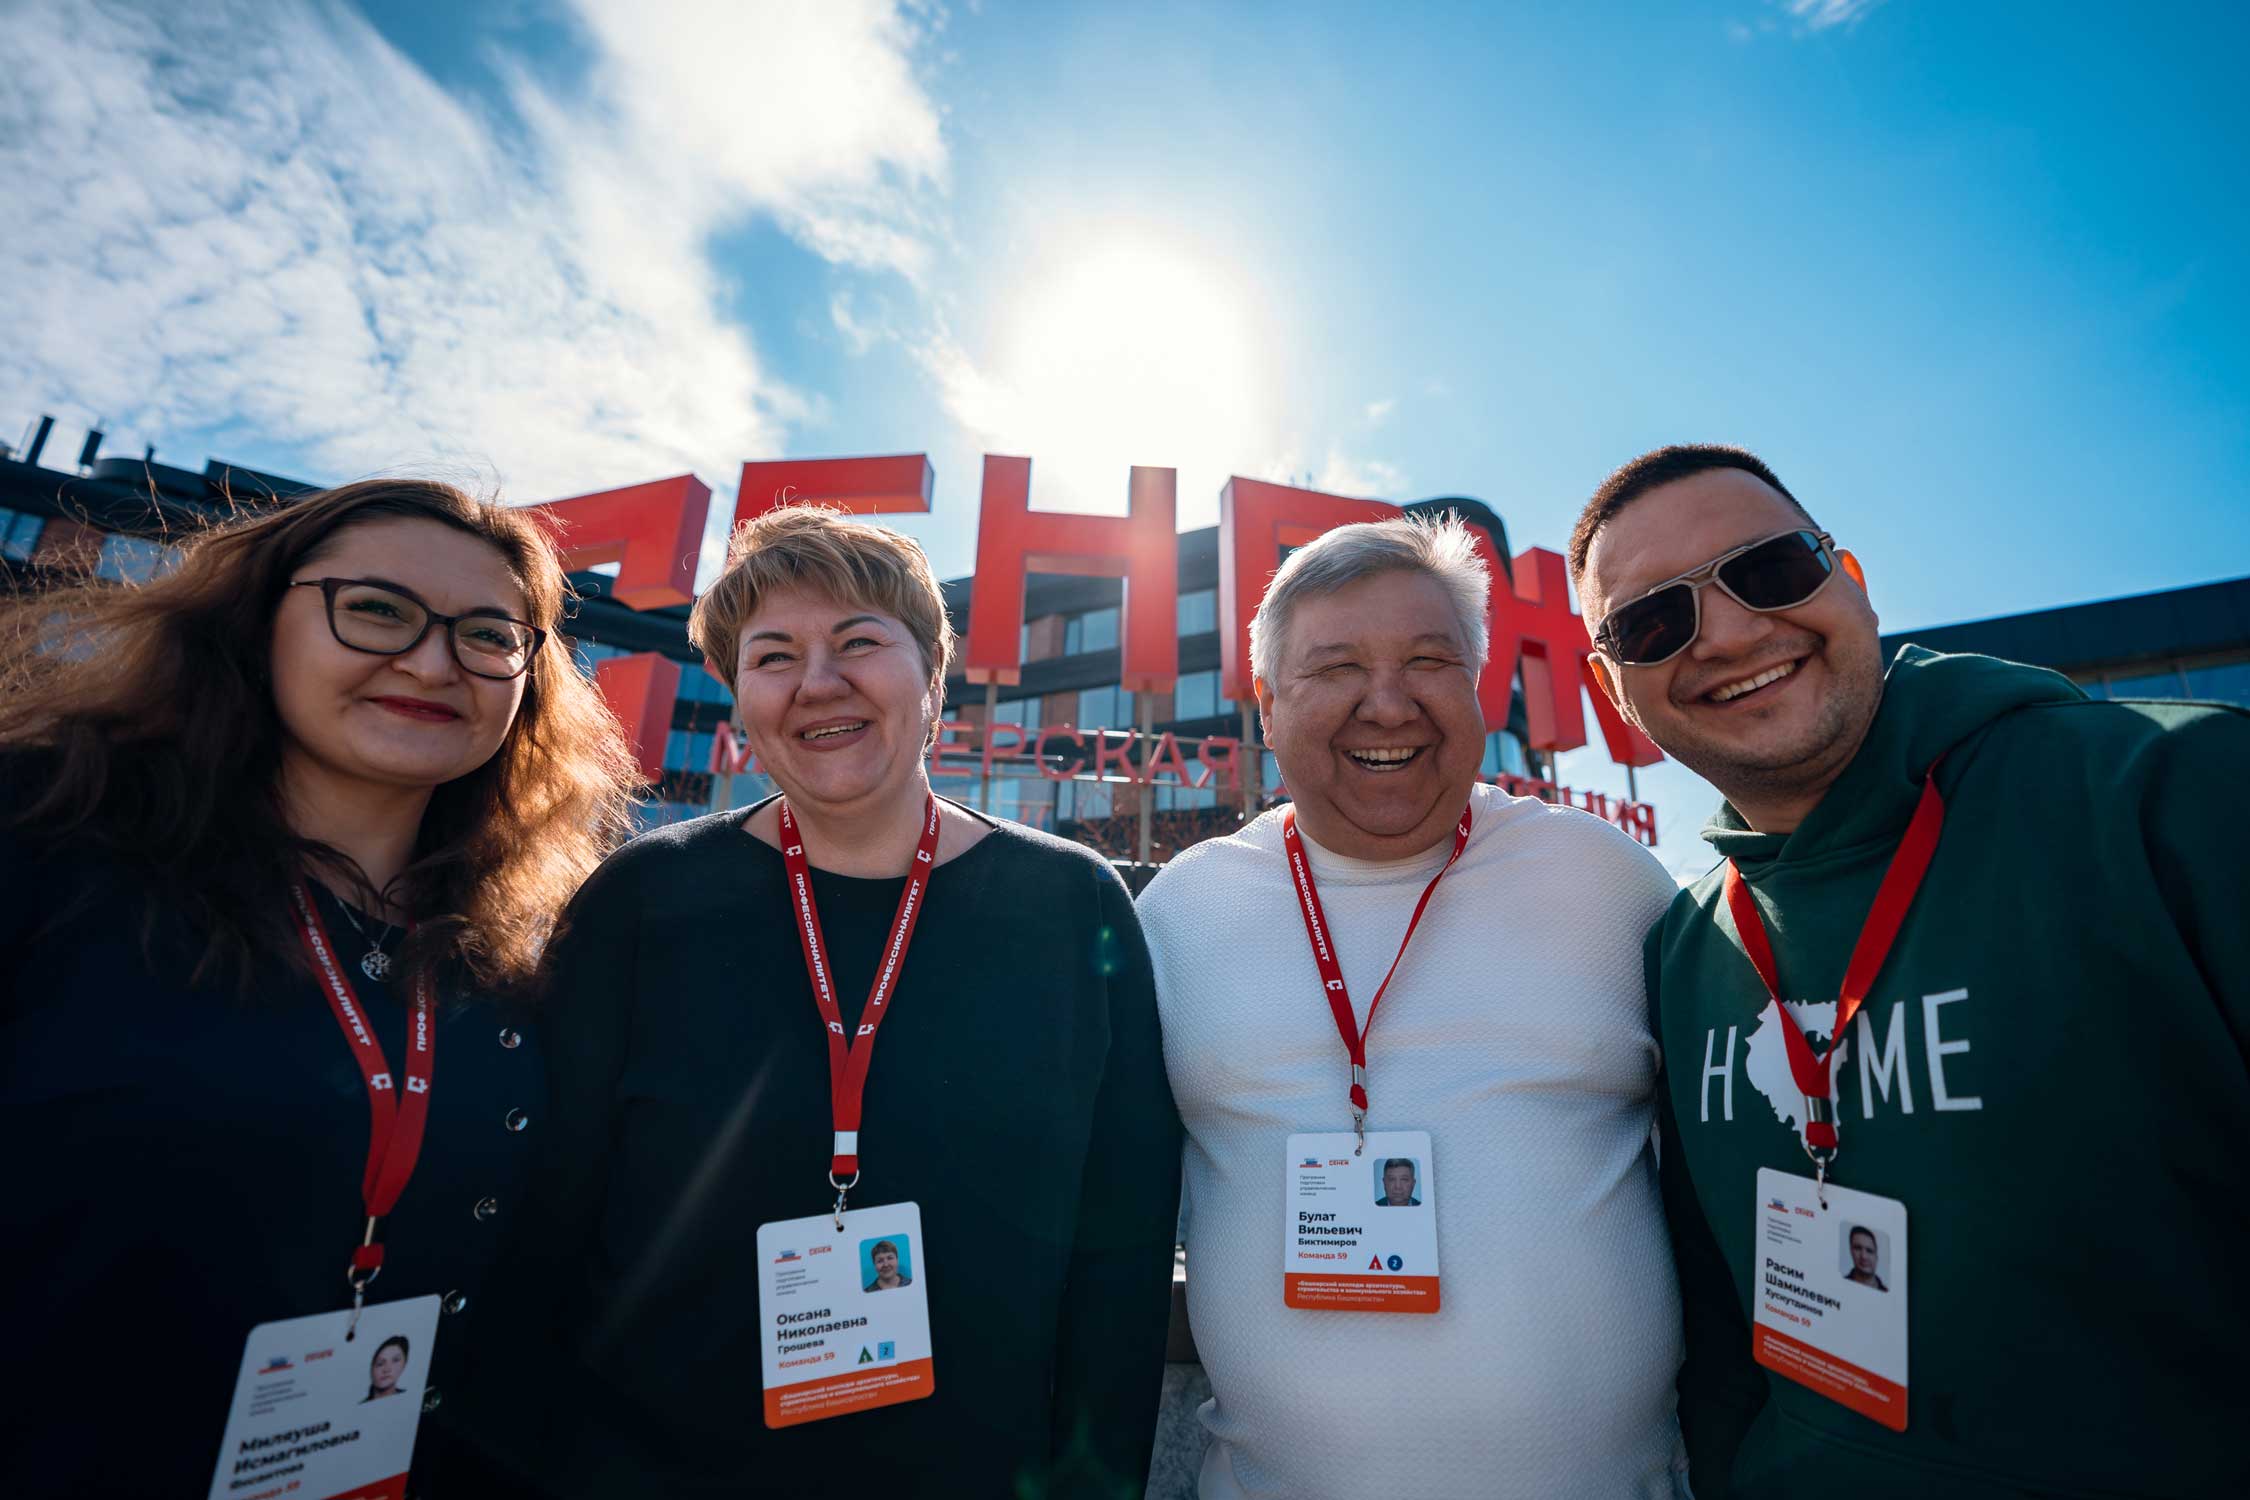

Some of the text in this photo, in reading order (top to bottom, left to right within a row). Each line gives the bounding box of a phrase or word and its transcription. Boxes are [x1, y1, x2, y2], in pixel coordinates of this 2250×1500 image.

[710, 721, 1240, 791] МЕРСКАЯ
[1292, 851, 1330, 963] ПРОФЕССИОНАЛИТЕТ
[795, 872, 831, 1002] ПРОФЕССИОНАЛИТЕТ
[873, 879, 921, 1006] ПРОФЕССИОНАЛИТЕТ
[1298, 1211, 1337, 1224] Булат
[1298, 1224, 1363, 1236] Вильевич
[1298, 1238, 1357, 1248] Биктимиров
[1298, 1252, 1335, 1261] Команда
[1765, 1257, 1805, 1281] Расим
[1765, 1272, 1842, 1312] Шамилевич
[776, 1306, 832, 1326] Оксана
[776, 1315, 868, 1342] Николаевна
[777, 1338, 825, 1356] Грошева
[778, 1354, 822, 1370] Команда
[238, 1420, 331, 1455] Миляуша
[233, 1429, 361, 1475] Исмагиловна
